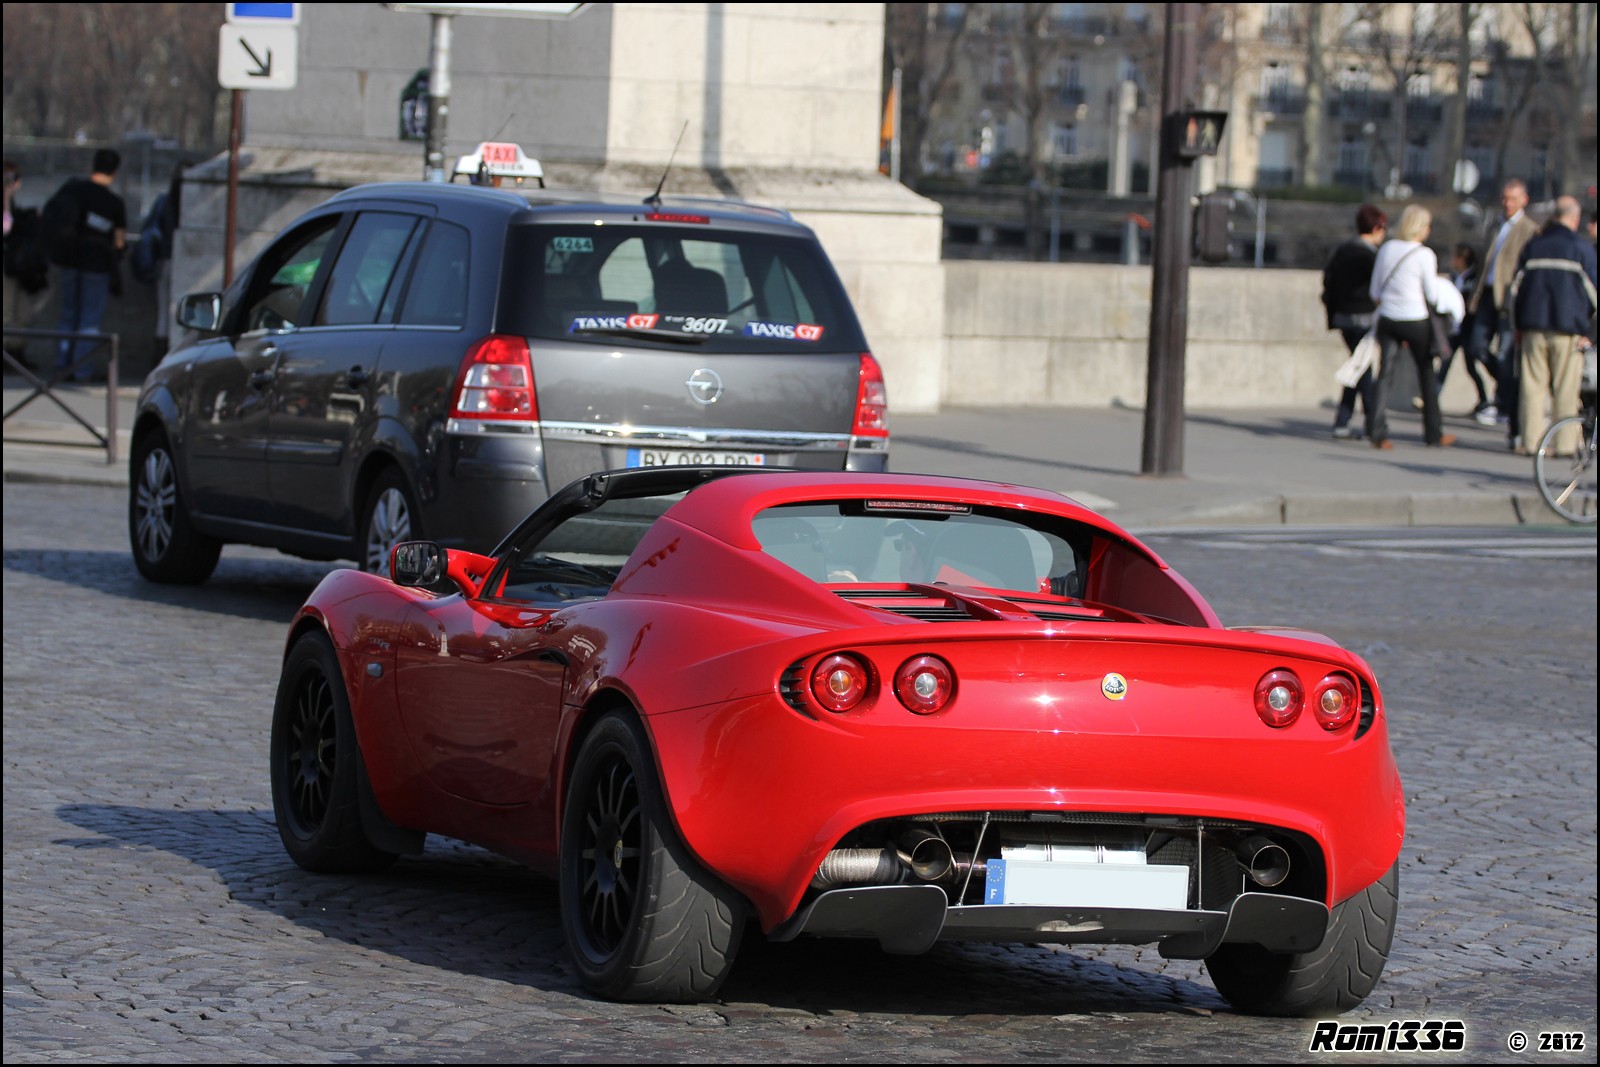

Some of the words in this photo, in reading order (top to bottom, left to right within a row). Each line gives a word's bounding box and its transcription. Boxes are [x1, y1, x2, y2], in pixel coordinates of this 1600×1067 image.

[485, 146, 518, 161] TAXI
[556, 238, 591, 249] 6264
[575, 316, 628, 329] TAXIS
[629, 315, 655, 329] G7
[682, 317, 728, 333] 3607
[748, 321, 795, 339] TAXIS
[796, 324, 822, 340] G7
[990, 888, 998, 900] F
